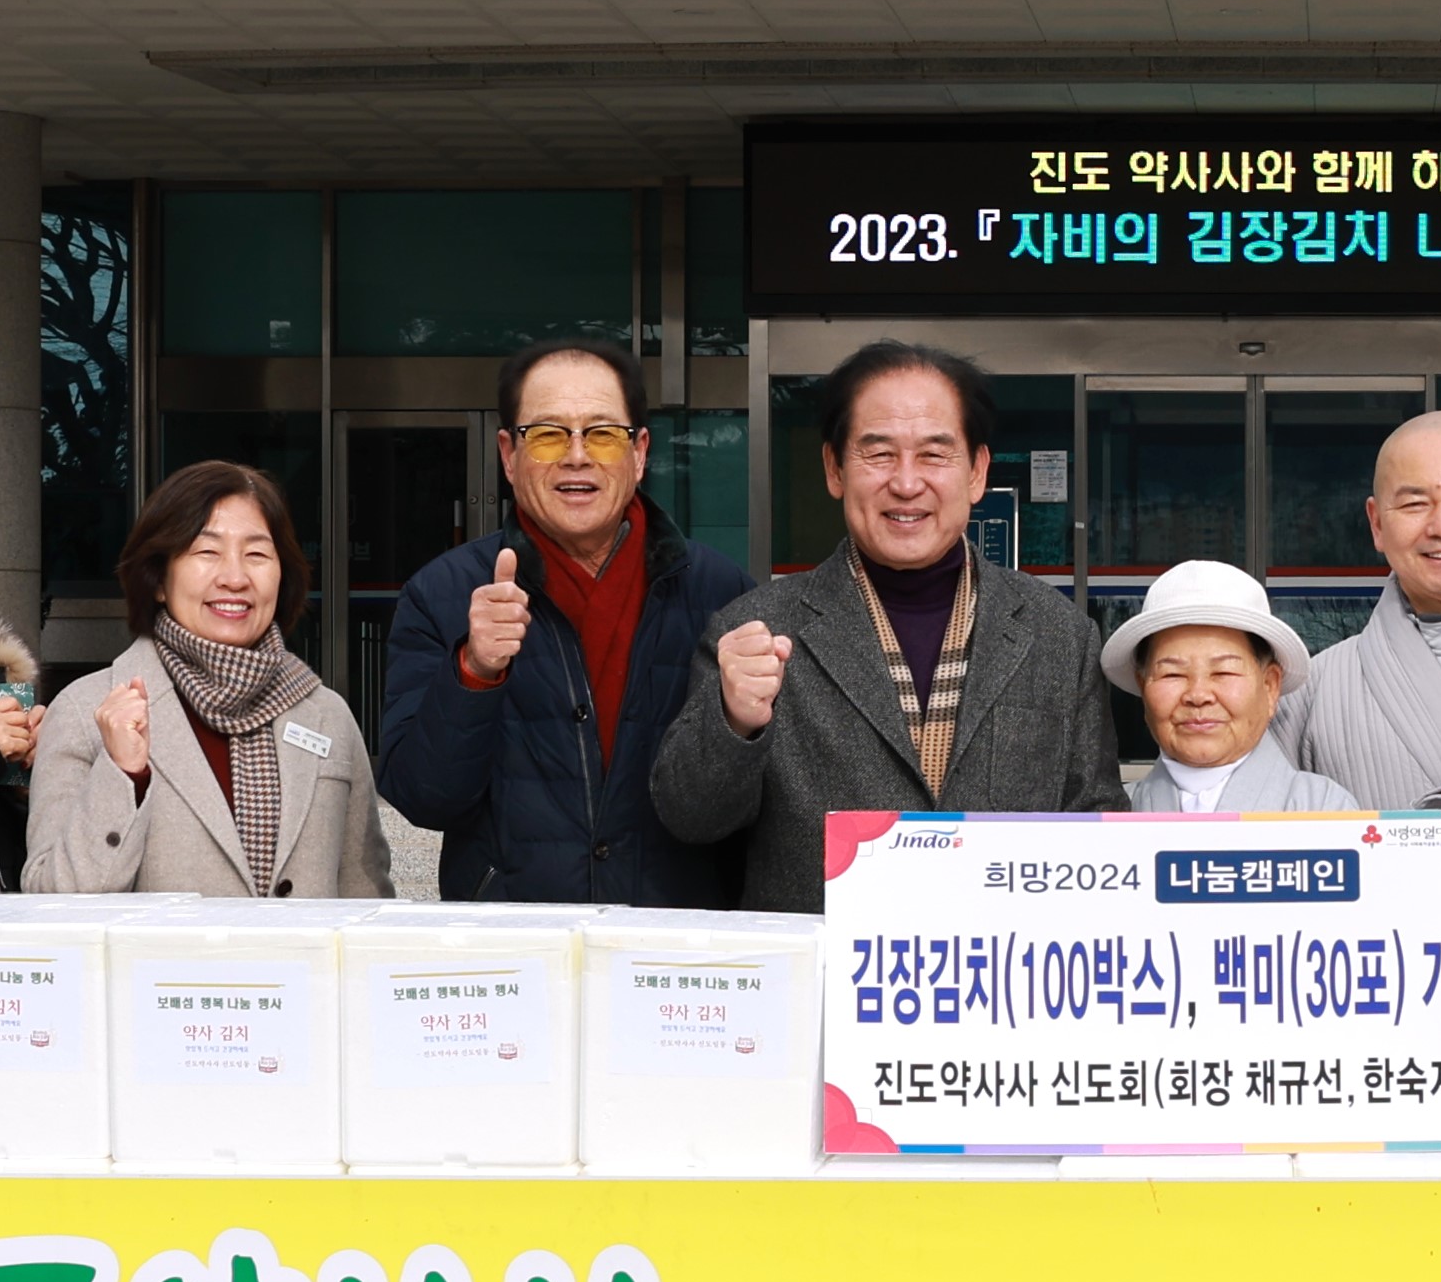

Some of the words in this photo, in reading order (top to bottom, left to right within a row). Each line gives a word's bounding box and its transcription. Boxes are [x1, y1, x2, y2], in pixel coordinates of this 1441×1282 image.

[1030, 152, 1110, 193] 진도
[1130, 150, 1296, 193] 약사사와
[1313, 151, 1392, 192] 함께
[830, 214, 957, 261] 2023.
[1188, 210, 1387, 262] 김장김치
[889, 833, 950, 849] Jindo
[985, 862, 1140, 893] 희망2024
[1171, 860, 1344, 892] 나눔캠페인
[1215, 929, 1404, 1027] 백미(30포)
[420, 1014, 451, 1032] 약사
[458, 1012, 487, 1031] 김치
[659, 1003, 689, 1021] 약사
[697, 1005, 726, 1022] 김치
[183, 1024, 213, 1042] 약사
[220, 1025, 248, 1042] 김치
[875, 1060, 1038, 1107] 진도약사사
